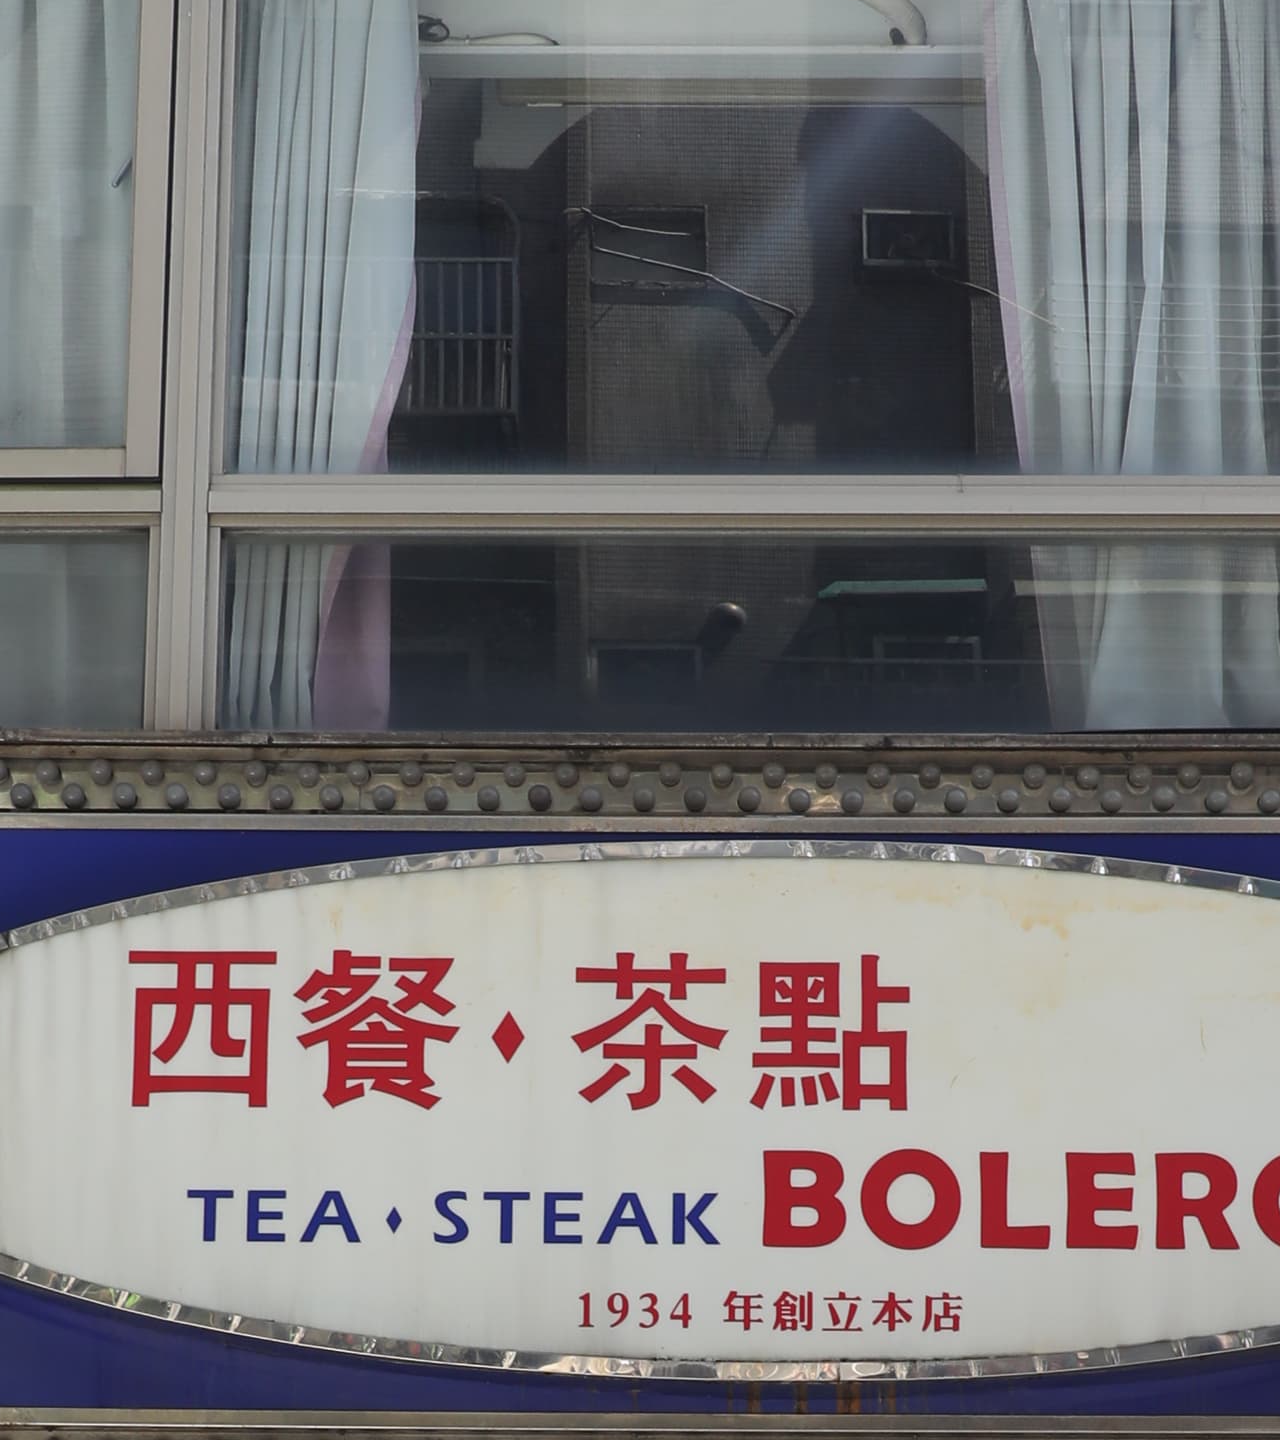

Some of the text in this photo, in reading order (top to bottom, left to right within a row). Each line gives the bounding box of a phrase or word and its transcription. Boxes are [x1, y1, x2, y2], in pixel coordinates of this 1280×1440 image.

[127, 948, 911, 1111] 西餐 茶點
[186, 1189, 362, 1243] TEA
[433, 1190, 720, 1245] STEAK
[578, 1290, 964, 1333] 1934 年創立本店
